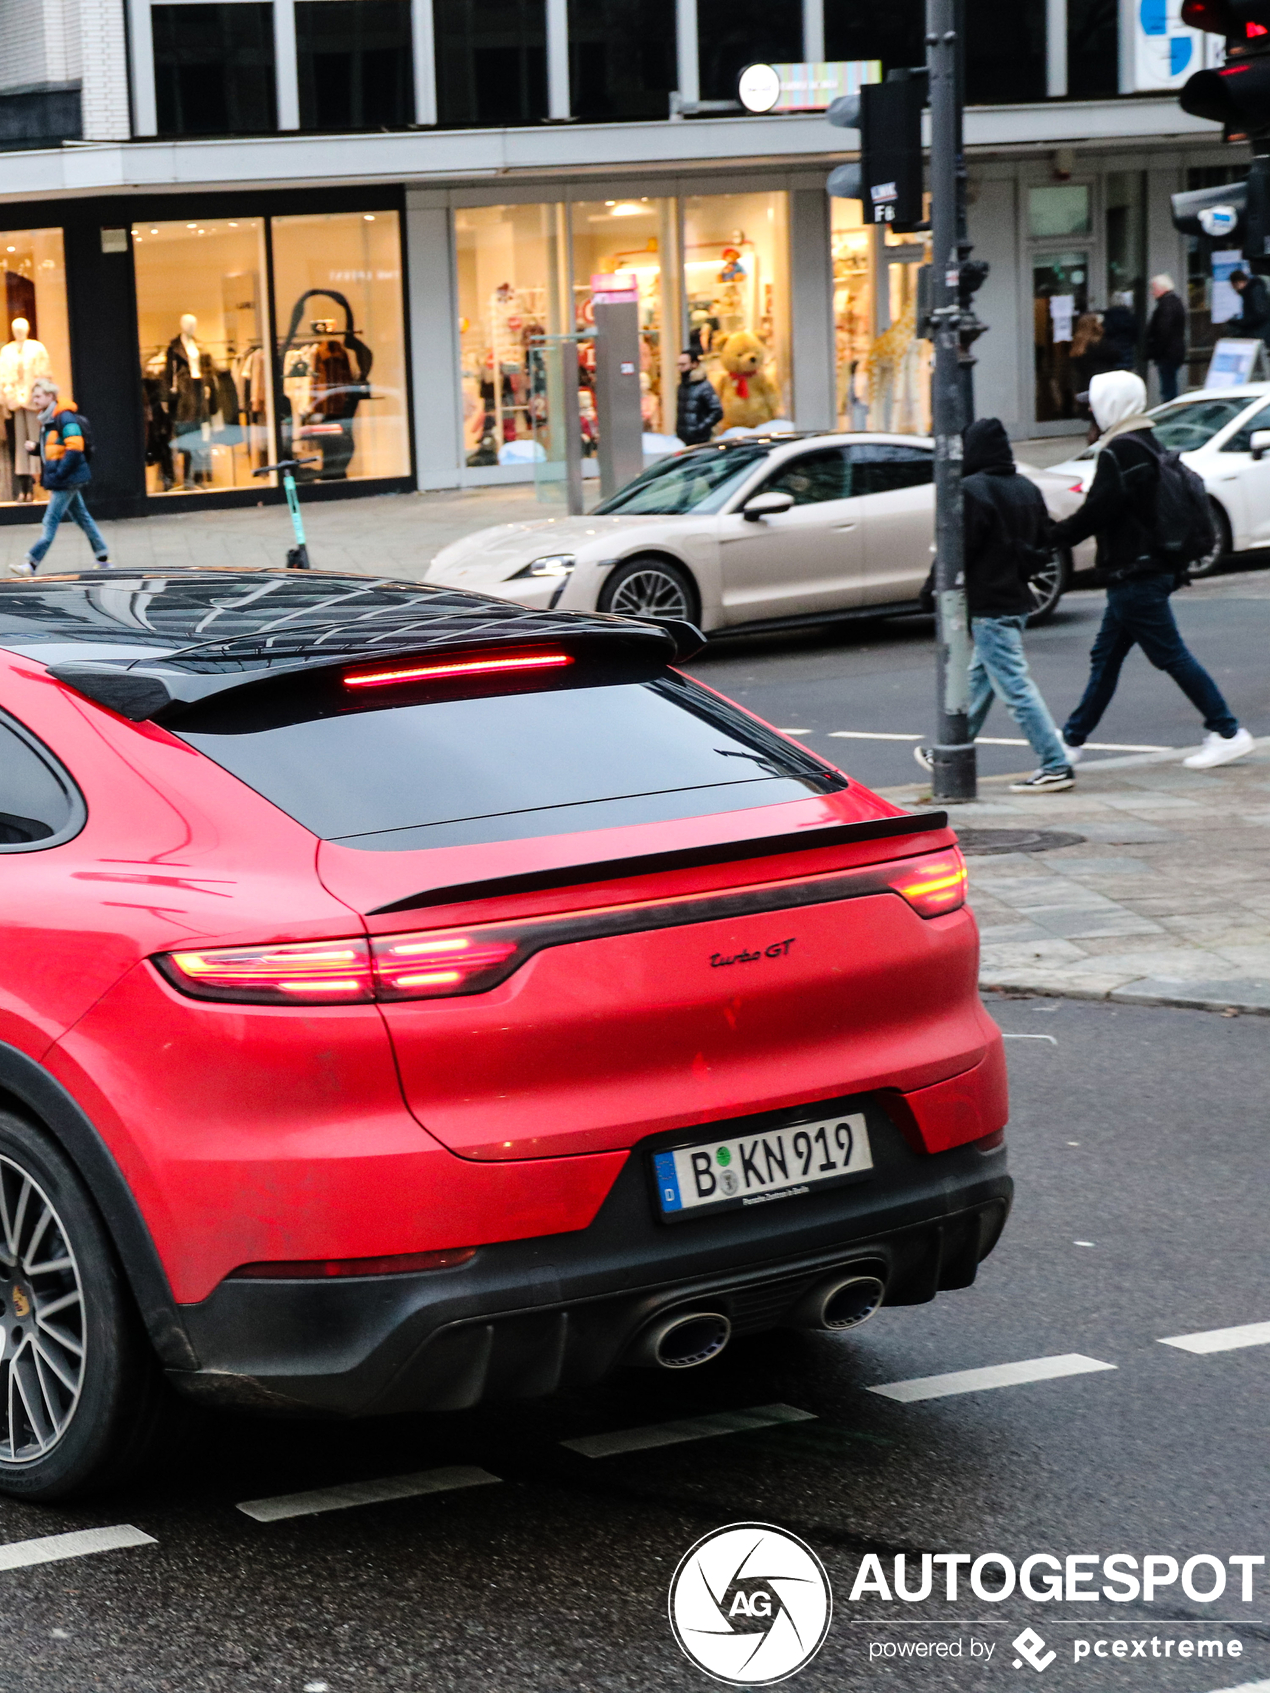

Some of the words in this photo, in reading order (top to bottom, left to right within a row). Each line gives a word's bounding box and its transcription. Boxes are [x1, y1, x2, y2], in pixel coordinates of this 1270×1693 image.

[765, 937, 796, 957] GT
[691, 1151, 717, 1198] B
[664, 1188, 675, 1202] D
